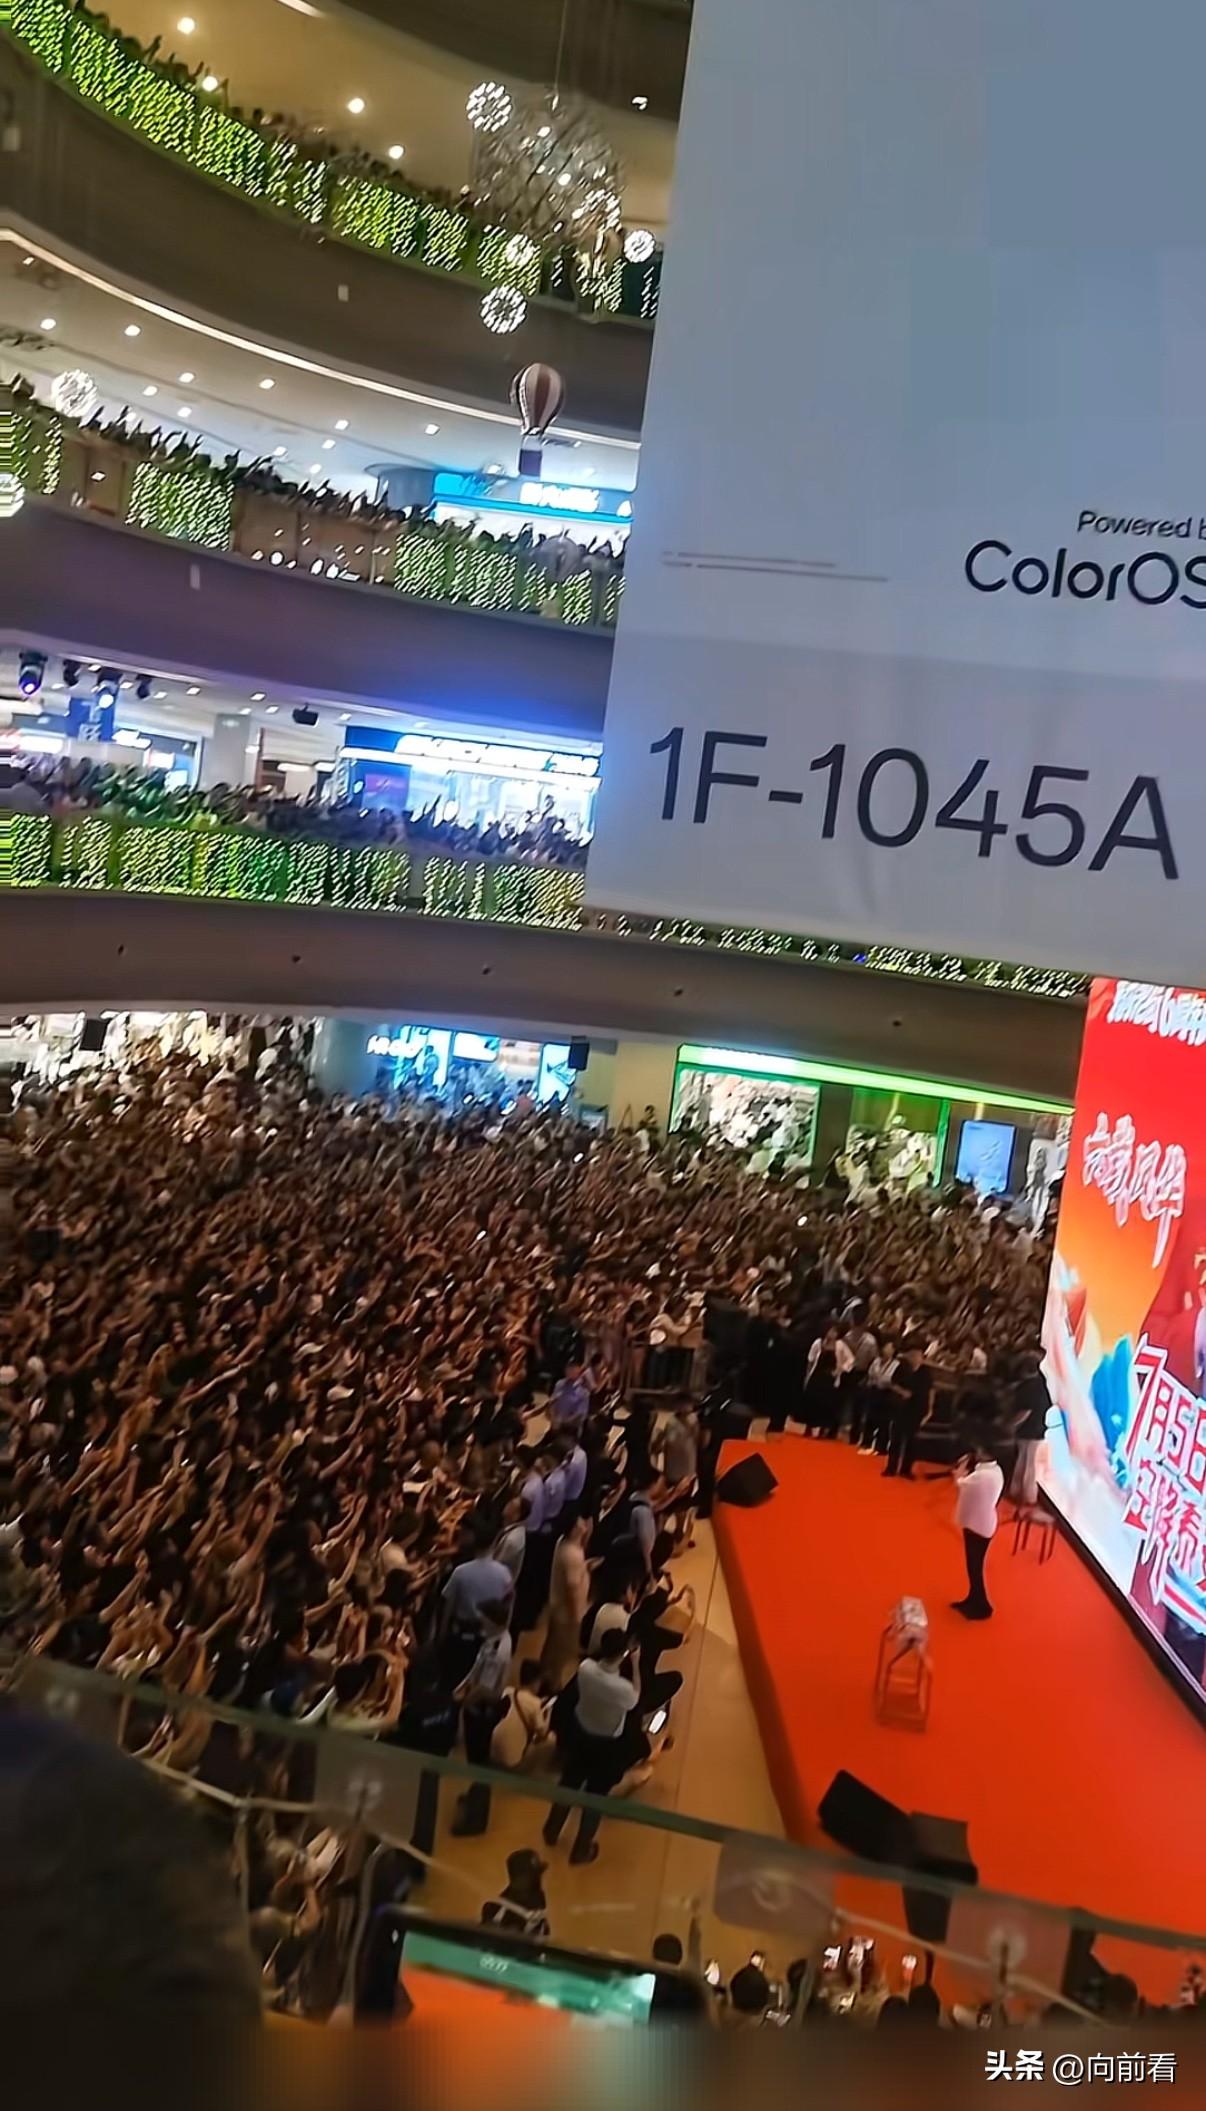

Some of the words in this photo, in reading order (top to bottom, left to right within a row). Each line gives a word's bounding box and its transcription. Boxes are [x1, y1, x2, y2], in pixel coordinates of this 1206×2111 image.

[965, 540, 1206, 609] ColorOS
[1077, 510, 1192, 539] Powered
[650, 727, 1179, 880] 1F-1045A
[1123, 1456, 1206, 1602] 空降泰
